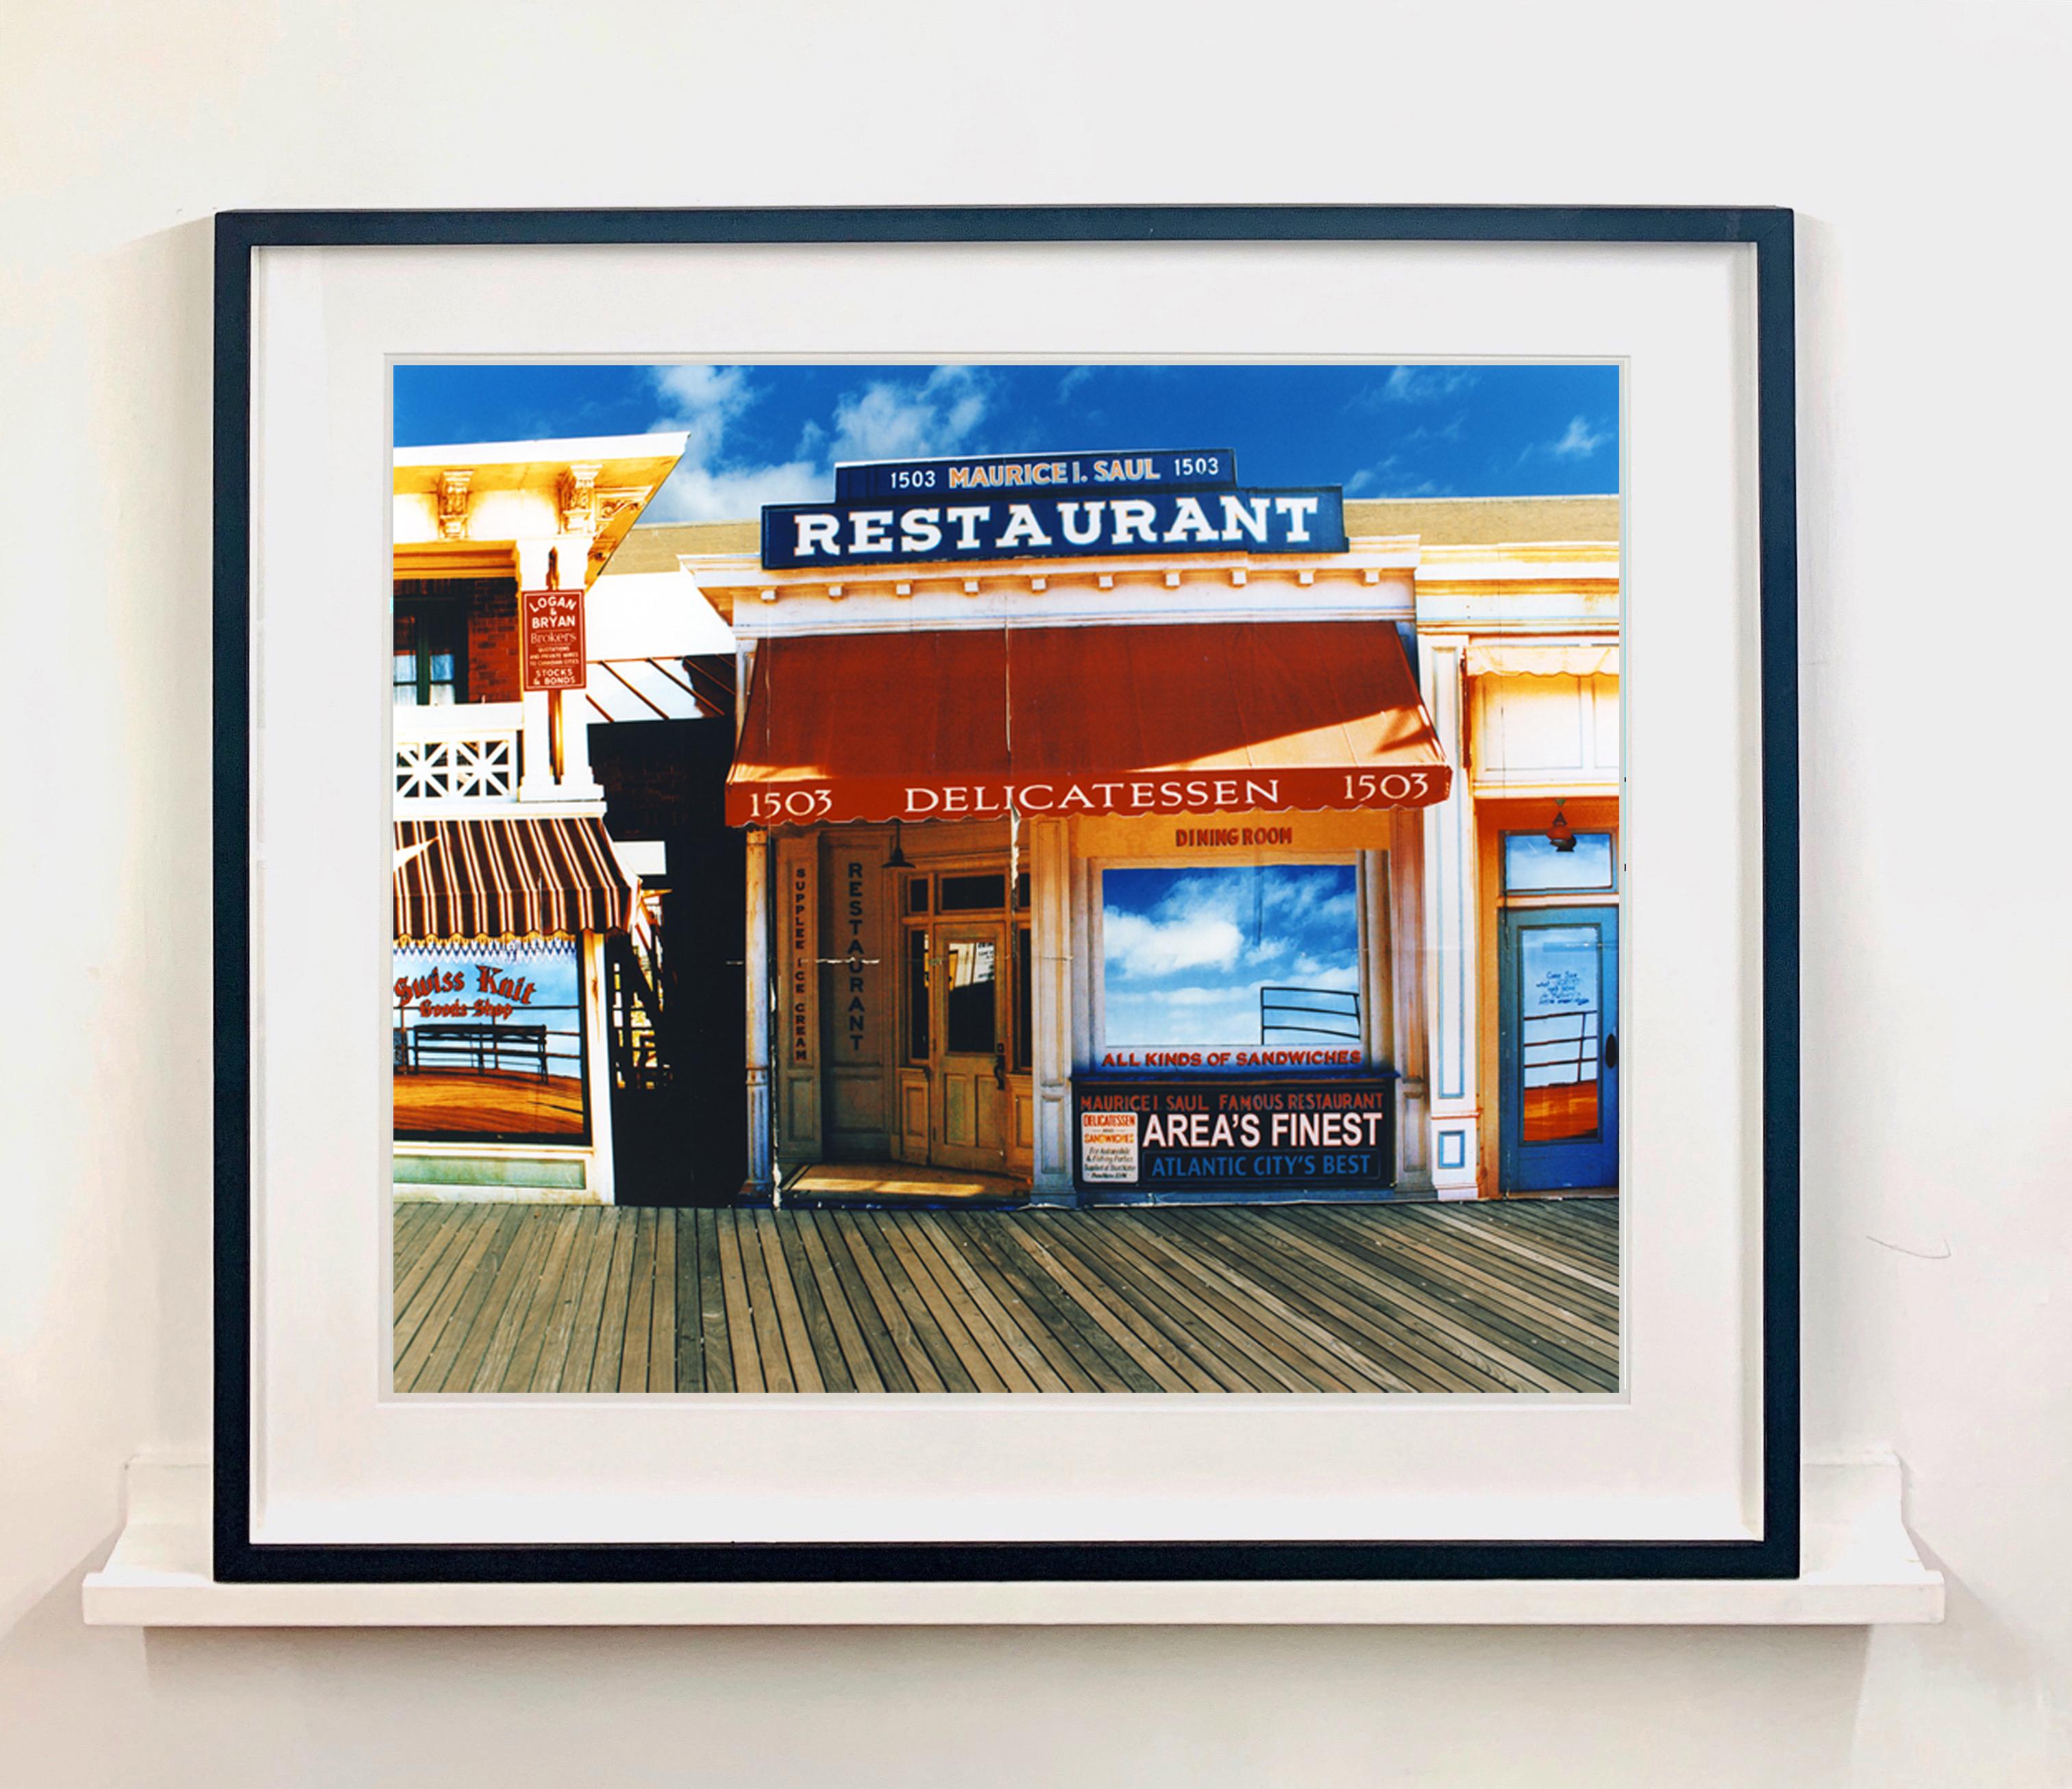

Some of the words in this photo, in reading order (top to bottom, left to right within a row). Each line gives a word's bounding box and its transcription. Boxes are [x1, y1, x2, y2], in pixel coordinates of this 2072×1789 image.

[891, 471, 936, 489] 1503
[948, 462, 1068, 489] MAURICE
[1072, 461, 1088, 484] I.
[1093, 458, 1161, 483] SAUL
[1174, 457, 1220, 476] 1503
[793, 495, 1319, 558] RESTAURANT
[529, 596, 577, 613] LOGAN
[550, 608, 557, 616] &
[532, 615, 576, 629] BRYAN
[530, 631, 577, 645] Brokers
[533, 677, 541, 685] &
[544, 676, 576, 684] BONDS
[536, 667, 573, 678] STOCKS
[750, 789, 832, 819] 1503
[904, 779, 1279, 813] DELICATESSEN
[1344, 773, 1429, 802] 1503
[1176, 827, 1240, 848] DINING
[1242, 826, 1293, 846] ROOM
[795, 867, 806, 950] SUPPLEE
[847, 862, 865, 1051] RESTAURANT
[393, 965, 465, 1007] Swiss
[475, 964, 537, 1005] Knit
[795, 957, 806, 994] ICE
[419, 998, 468, 1018] Goods
[471, 998, 513, 1020] Shop
[795, 1002, 807, 1061] CREAM
[1102, 1053, 1141, 1068] ALL
[1145, 1052, 1202, 1067] KINDS
[1207, 1052, 1232, 1066] OF
[1236, 1050, 1362, 1065] SANDWICHES
[1081, 1095, 1150, 1111] MAURICE
[1166, 1094, 1209, 1111] SAUL
[1218, 1094, 1284, 1111] FAMOUS
[1288, 1092, 1384, 1110] RESTAURANT
[1083, 1114, 1135, 1127] DELICATESSEN
[1142, 1113, 1261, 1148] AREA'S
[1271, 1112, 1383, 1147] FINEST
[1084, 1133, 1135, 1144] SANDWICHES
[1152, 1156, 1247, 1177] ATLANTIC
[1253, 1155, 1316, 1176] CITY'S
[1322, 1154, 1371, 1175] BEST
